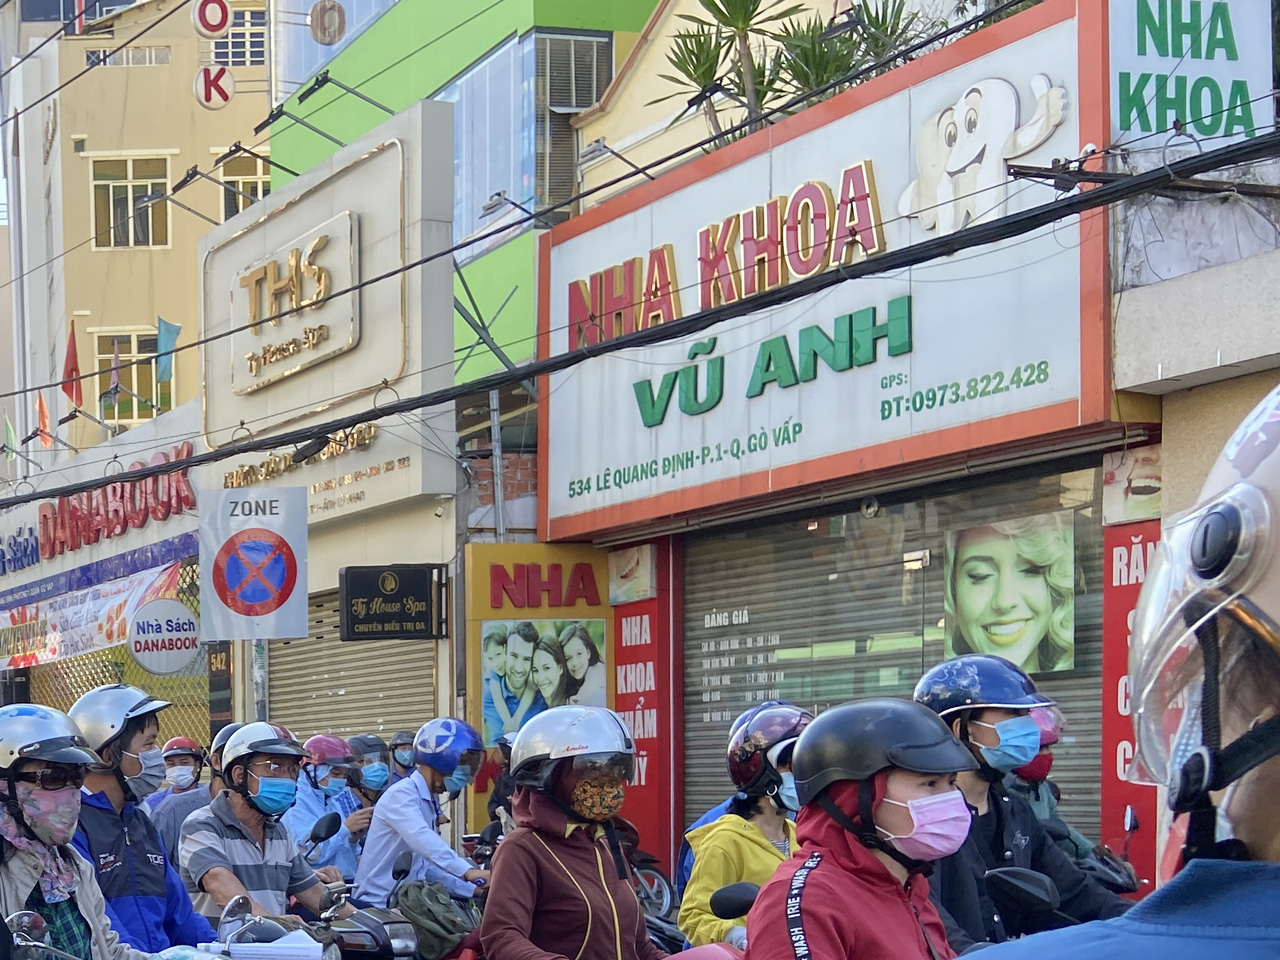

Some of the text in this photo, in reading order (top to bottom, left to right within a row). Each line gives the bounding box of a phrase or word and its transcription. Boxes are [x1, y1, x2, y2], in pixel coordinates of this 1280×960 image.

[1137, 0, 1239, 61] NHA
[1119, 72, 1256, 139] KHOA
[696, 159, 887, 312] KHOA
[239, 234, 332, 337] THS
[568, 243, 683, 351] NHA
[745, 294, 913, 400] ANH
[632, 336, 725, 430] VŨ
[880, 372, 909, 390] GPS:
[568, 476, 592, 499] 534
[595, 467, 611, 492] LÊ
[613, 459, 658, 490] QUANG
[772, 415, 803, 448] VẤP
[38, 441, 197, 560] DANABOOK
[229, 499, 280, 517] ZONE
[489, 562, 601, 609] NHA
[368, 597, 401, 614] House
[403, 595, 426, 617] Spa
[704, 605, 750, 629] BẢNG GIÁ
[136, 617, 196, 636] Nhà Sách
[354, 621, 382, 632] CHUYÊN
[415, 621, 426, 630] DA
[621, 614, 652, 648] NHA
[134, 636, 199, 654] DANABOOK
[211, 652, 227, 672] 542
[616, 661, 656, 695] KHOA
[787, 896, 801, 919] IRIE
[790, 927, 810, 958] WASH
